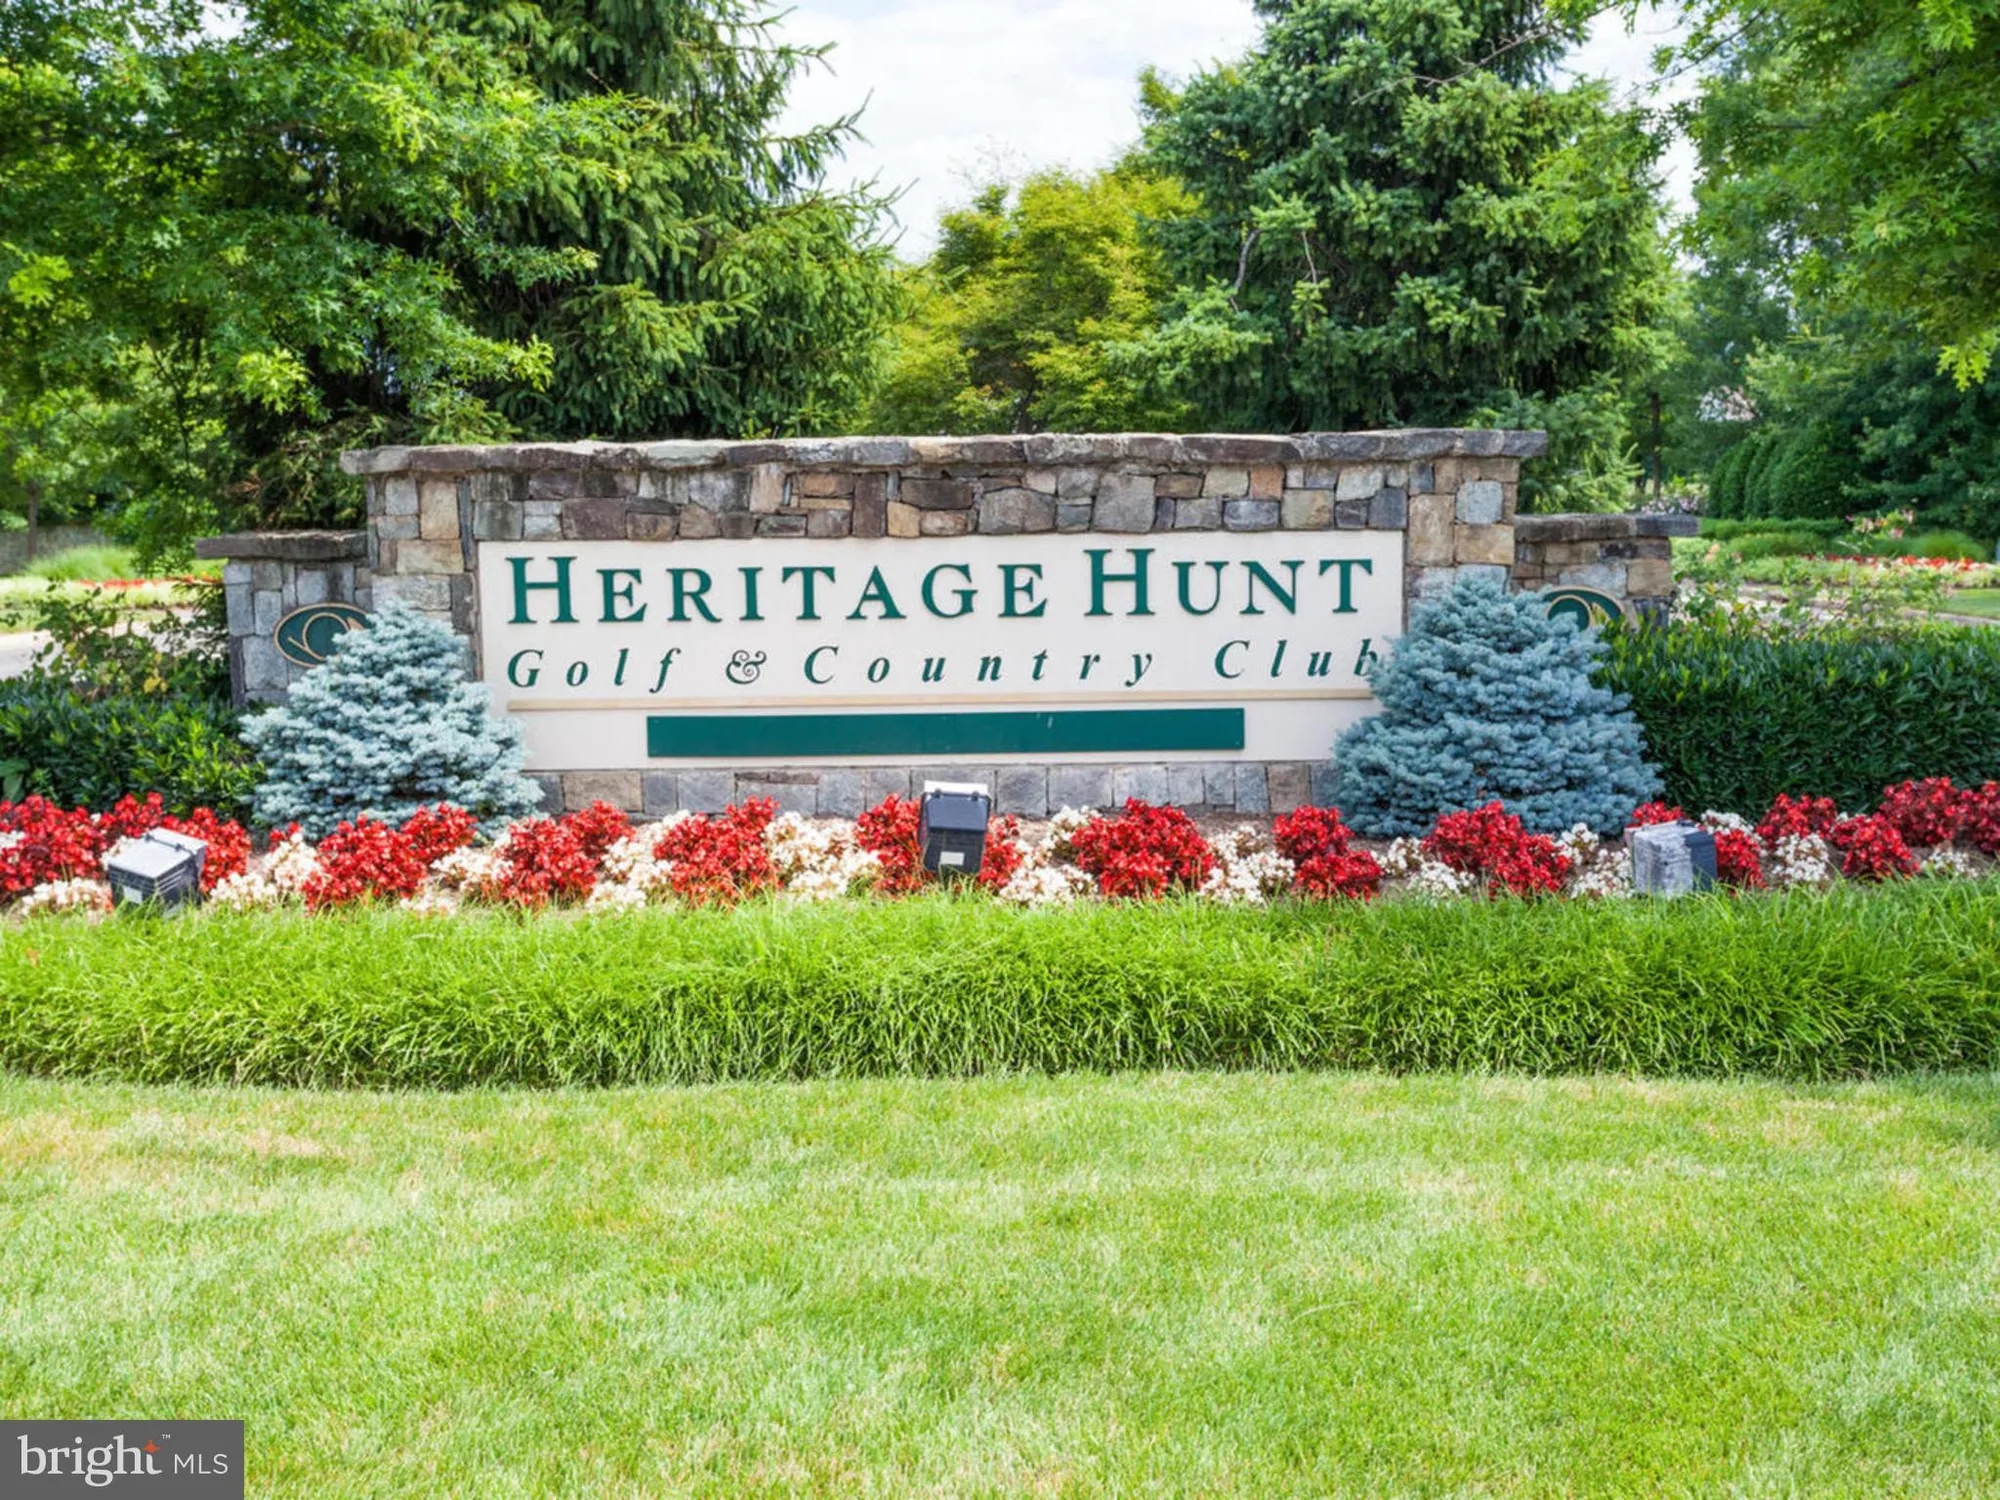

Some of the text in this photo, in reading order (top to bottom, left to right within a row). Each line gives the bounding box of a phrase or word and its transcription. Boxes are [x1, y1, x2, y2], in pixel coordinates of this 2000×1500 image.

[505, 548, 1373, 624] HERITAGE HUNT
[507, 638, 1378, 694] Golf & Country Club
